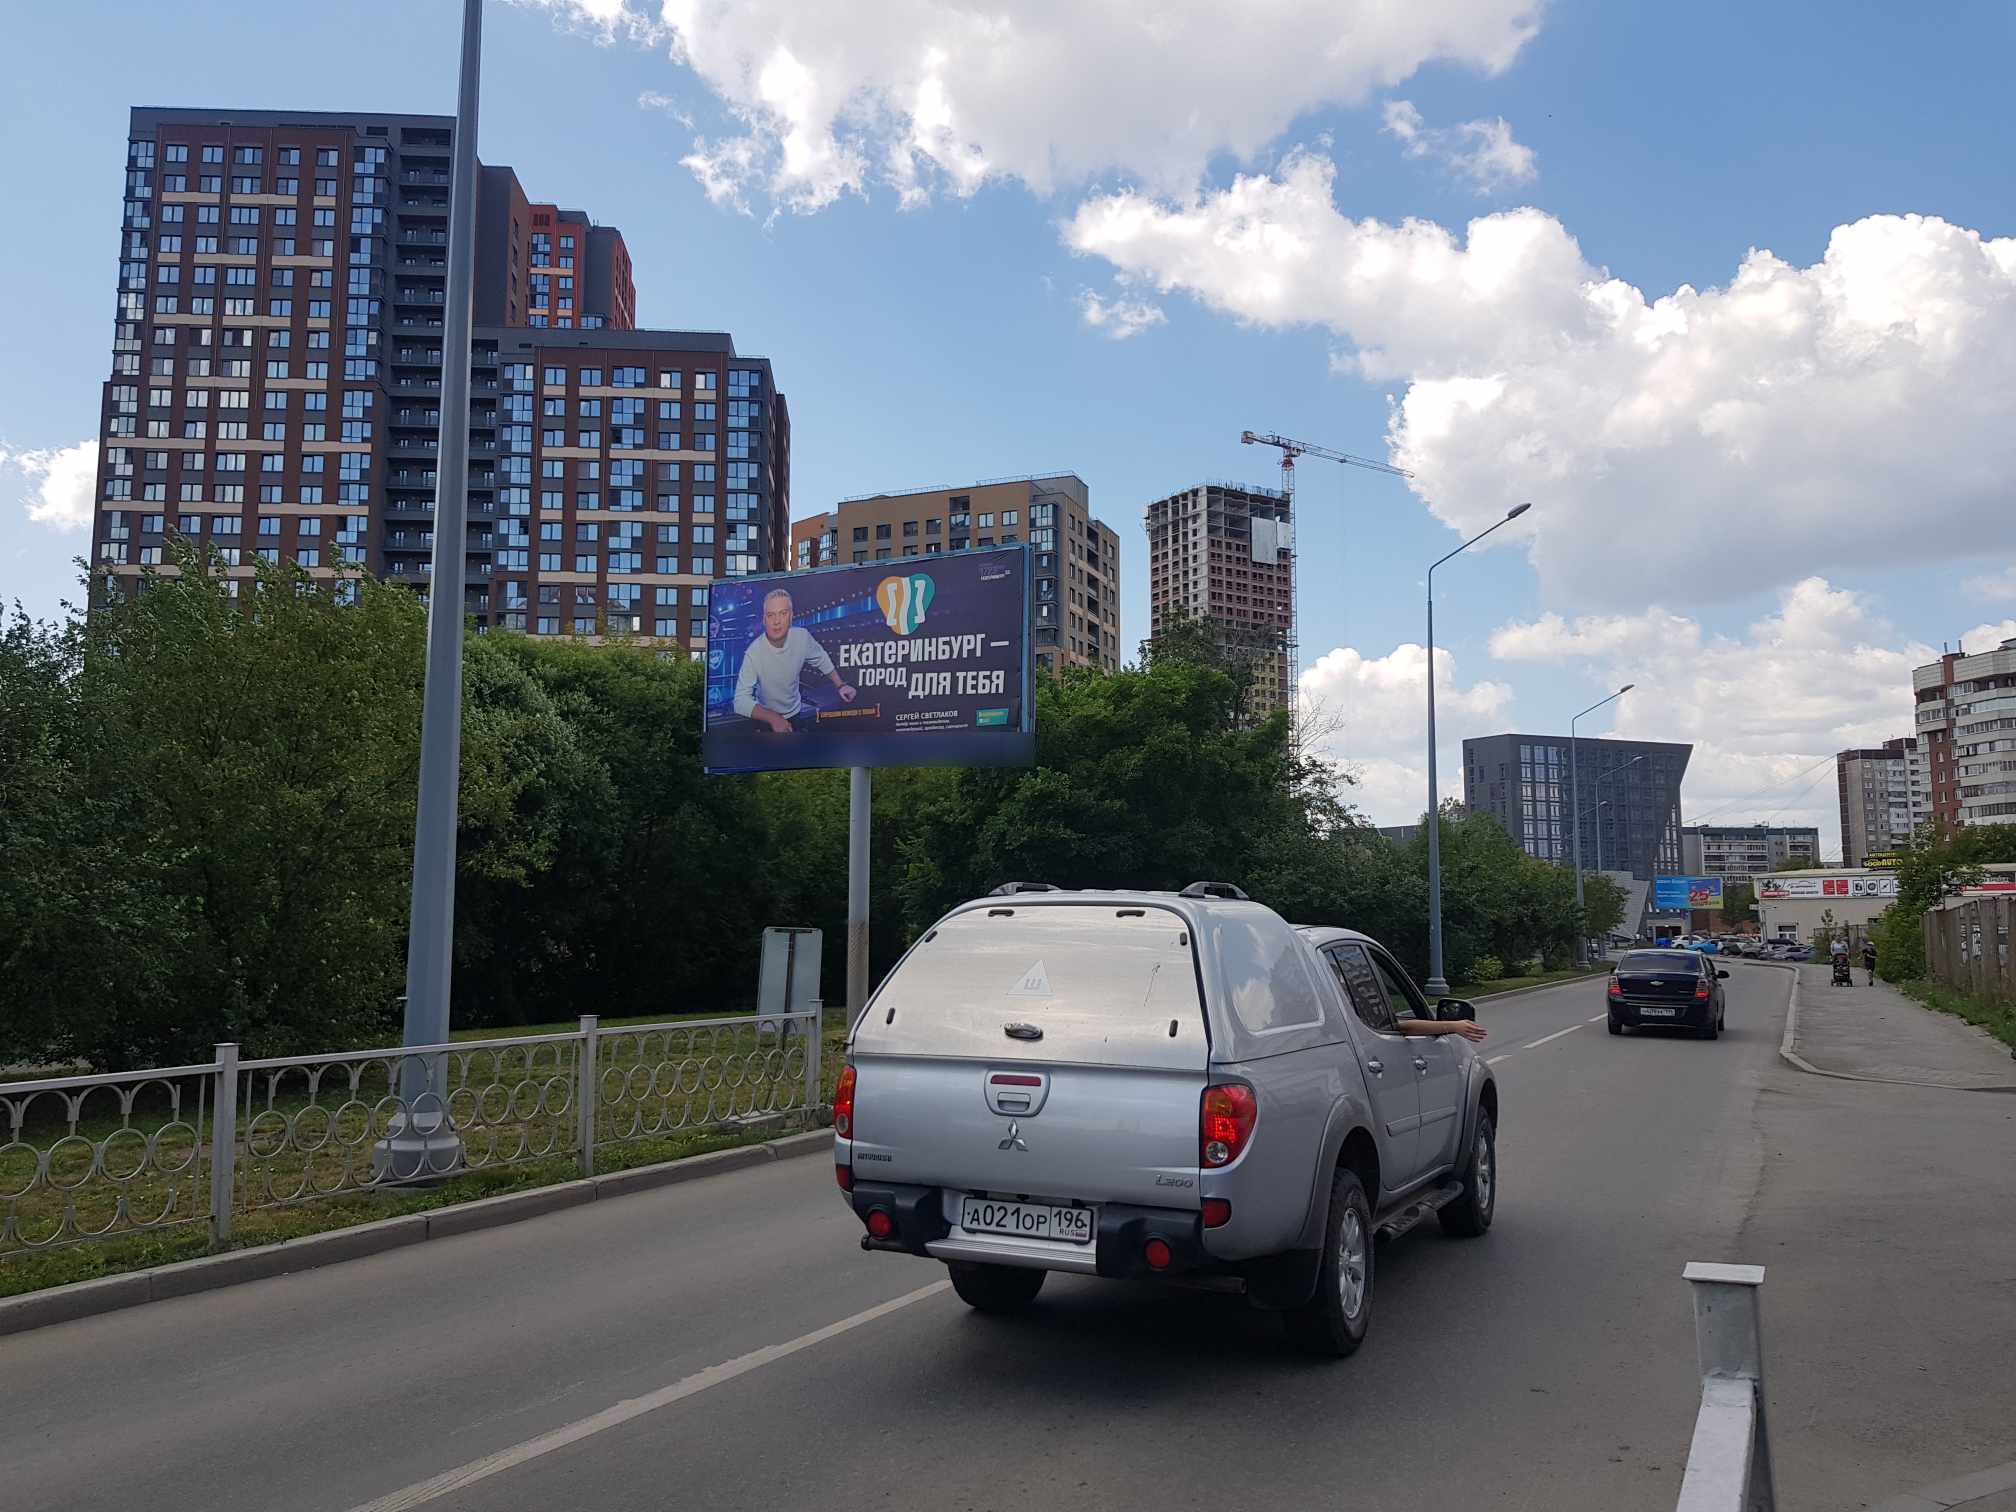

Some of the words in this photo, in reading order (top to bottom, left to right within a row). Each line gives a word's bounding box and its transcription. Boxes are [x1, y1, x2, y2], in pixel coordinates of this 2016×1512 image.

[858, 666, 908, 688] ГОРОД
[908, 672, 952, 699] ДЛЯ
[956, 670, 1006, 695] ТЕБЯ
[895, 711, 920, 721] СЕРГЕЙ
[920, 710, 959, 719] СВЕТЛАКОВ
[1023, 978, 1042, 990] Ш
